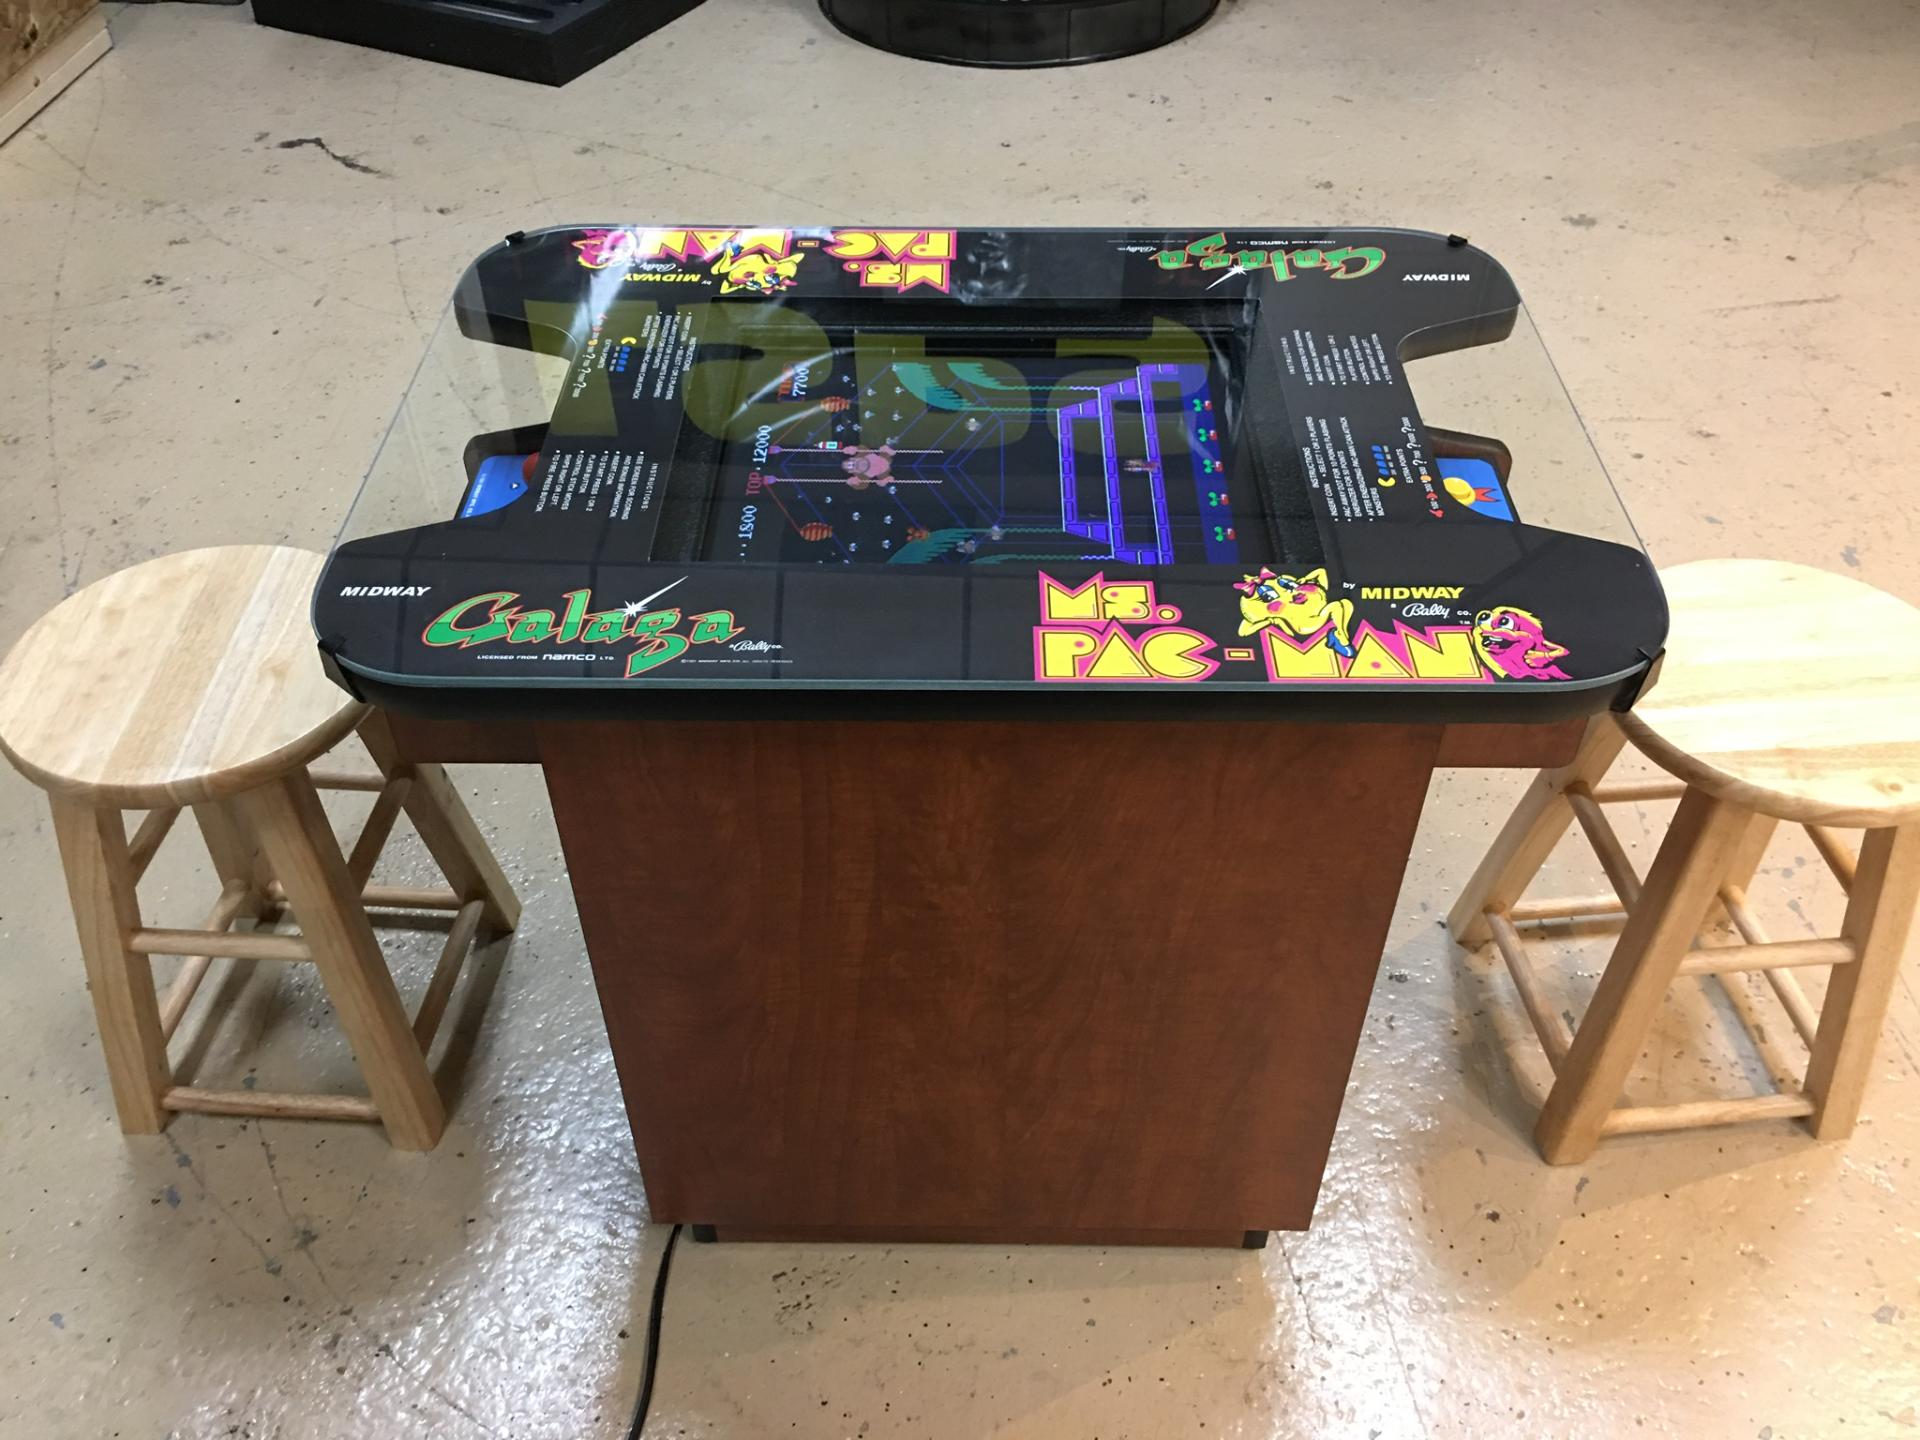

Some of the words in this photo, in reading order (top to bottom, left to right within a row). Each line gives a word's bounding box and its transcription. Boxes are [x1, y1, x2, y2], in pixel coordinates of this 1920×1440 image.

[1149, 232, 1386, 281] Galaga
[620, 273, 701, 282] MIDWAY
[1403, 273, 1470, 282] MIDWAY
[792, 367, 810, 397] 7700
[752, 425, 773, 464] 12000
[745, 471, 763, 496] TOP
[738, 505, 758, 540] 1800
[340, 586, 431, 597] MIDWAY
[1361, 586, 1464, 600] MIDWAY
[1402, 602, 1450, 619] Bally
[421, 588, 746, 678] Galaga
[542, 653, 596, 661] namco
[733, 640, 771, 654] Bally
[1033, 616, 1495, 683] PAC-MAN
